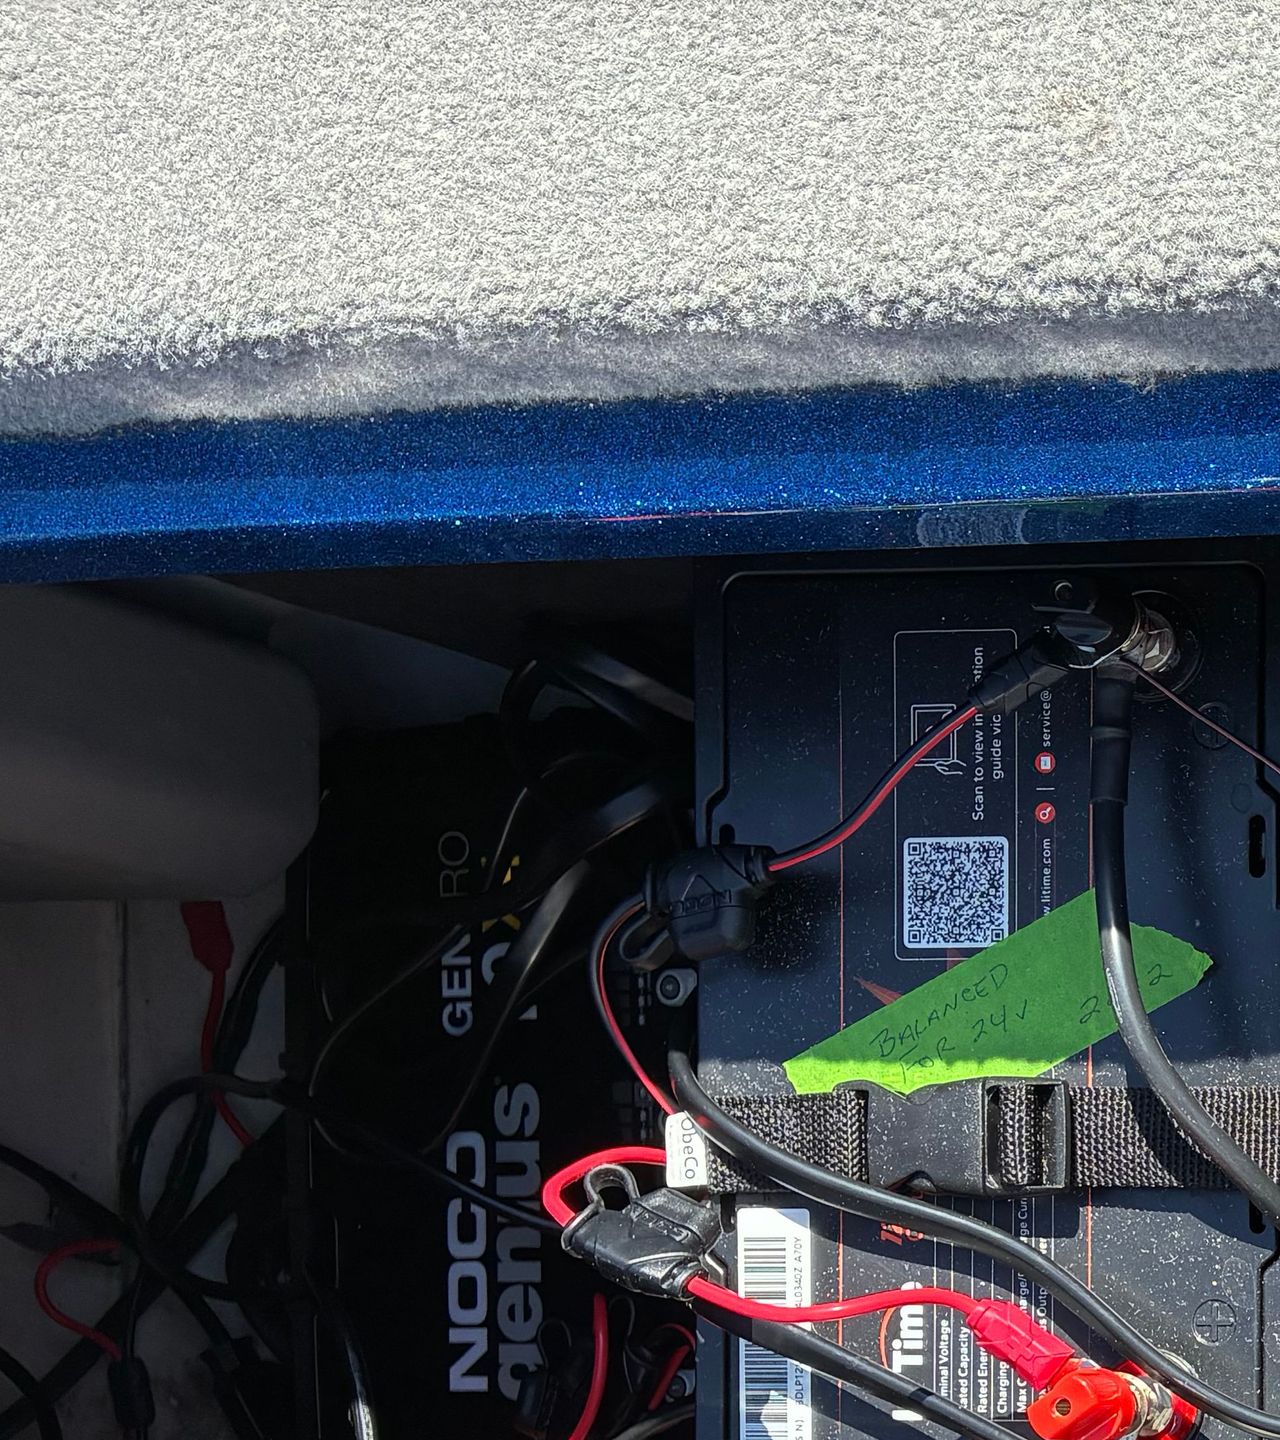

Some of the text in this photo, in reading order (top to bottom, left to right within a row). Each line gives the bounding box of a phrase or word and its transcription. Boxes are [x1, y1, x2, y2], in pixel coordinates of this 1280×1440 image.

[972, 731, 984, 820] Scan to view
[991, 748, 1006, 779] guide
[868, 963, 1010, 1058] BALANCED
[446, 1130, 489, 1392] NOCO
[493, 1082, 543, 1401] genus
[938, 1320, 950, 1364] Voltage
[957, 1327, 971, 1378] Capacity
[977, 1380, 989, 1413] Rated
